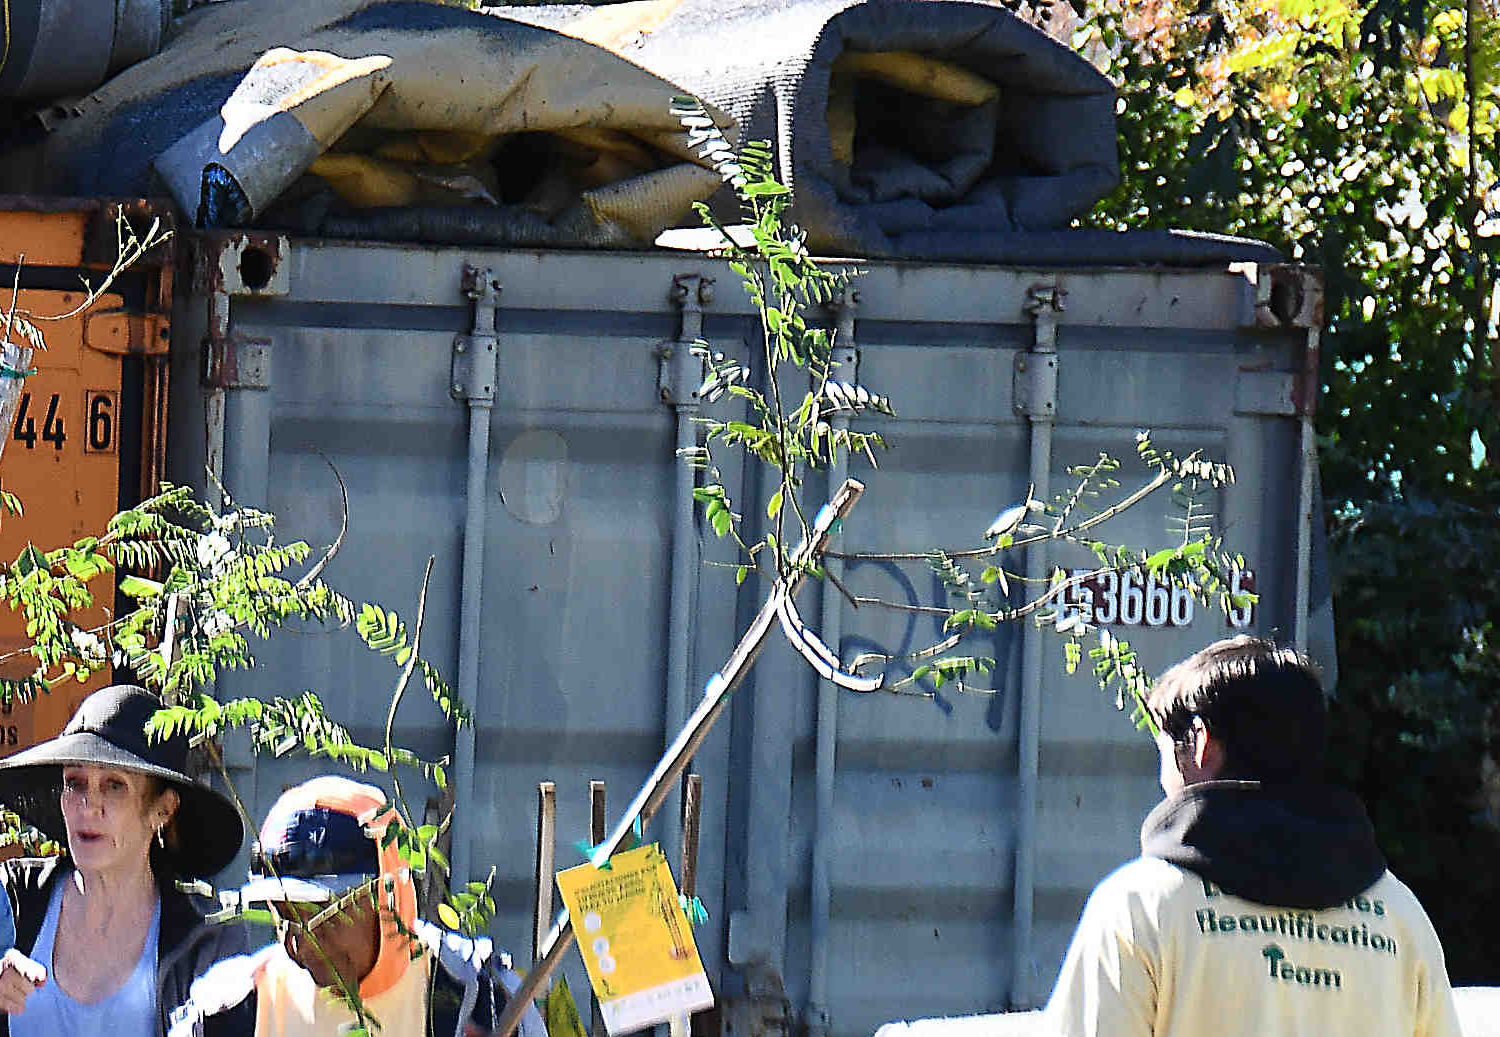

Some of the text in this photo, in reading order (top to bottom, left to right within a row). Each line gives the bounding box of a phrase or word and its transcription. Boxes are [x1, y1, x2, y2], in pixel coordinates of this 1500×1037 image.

[90, 393, 113, 450] 6
[1196, 907, 1397, 956] Beautification
[1262, 944, 1342, 988] Team
